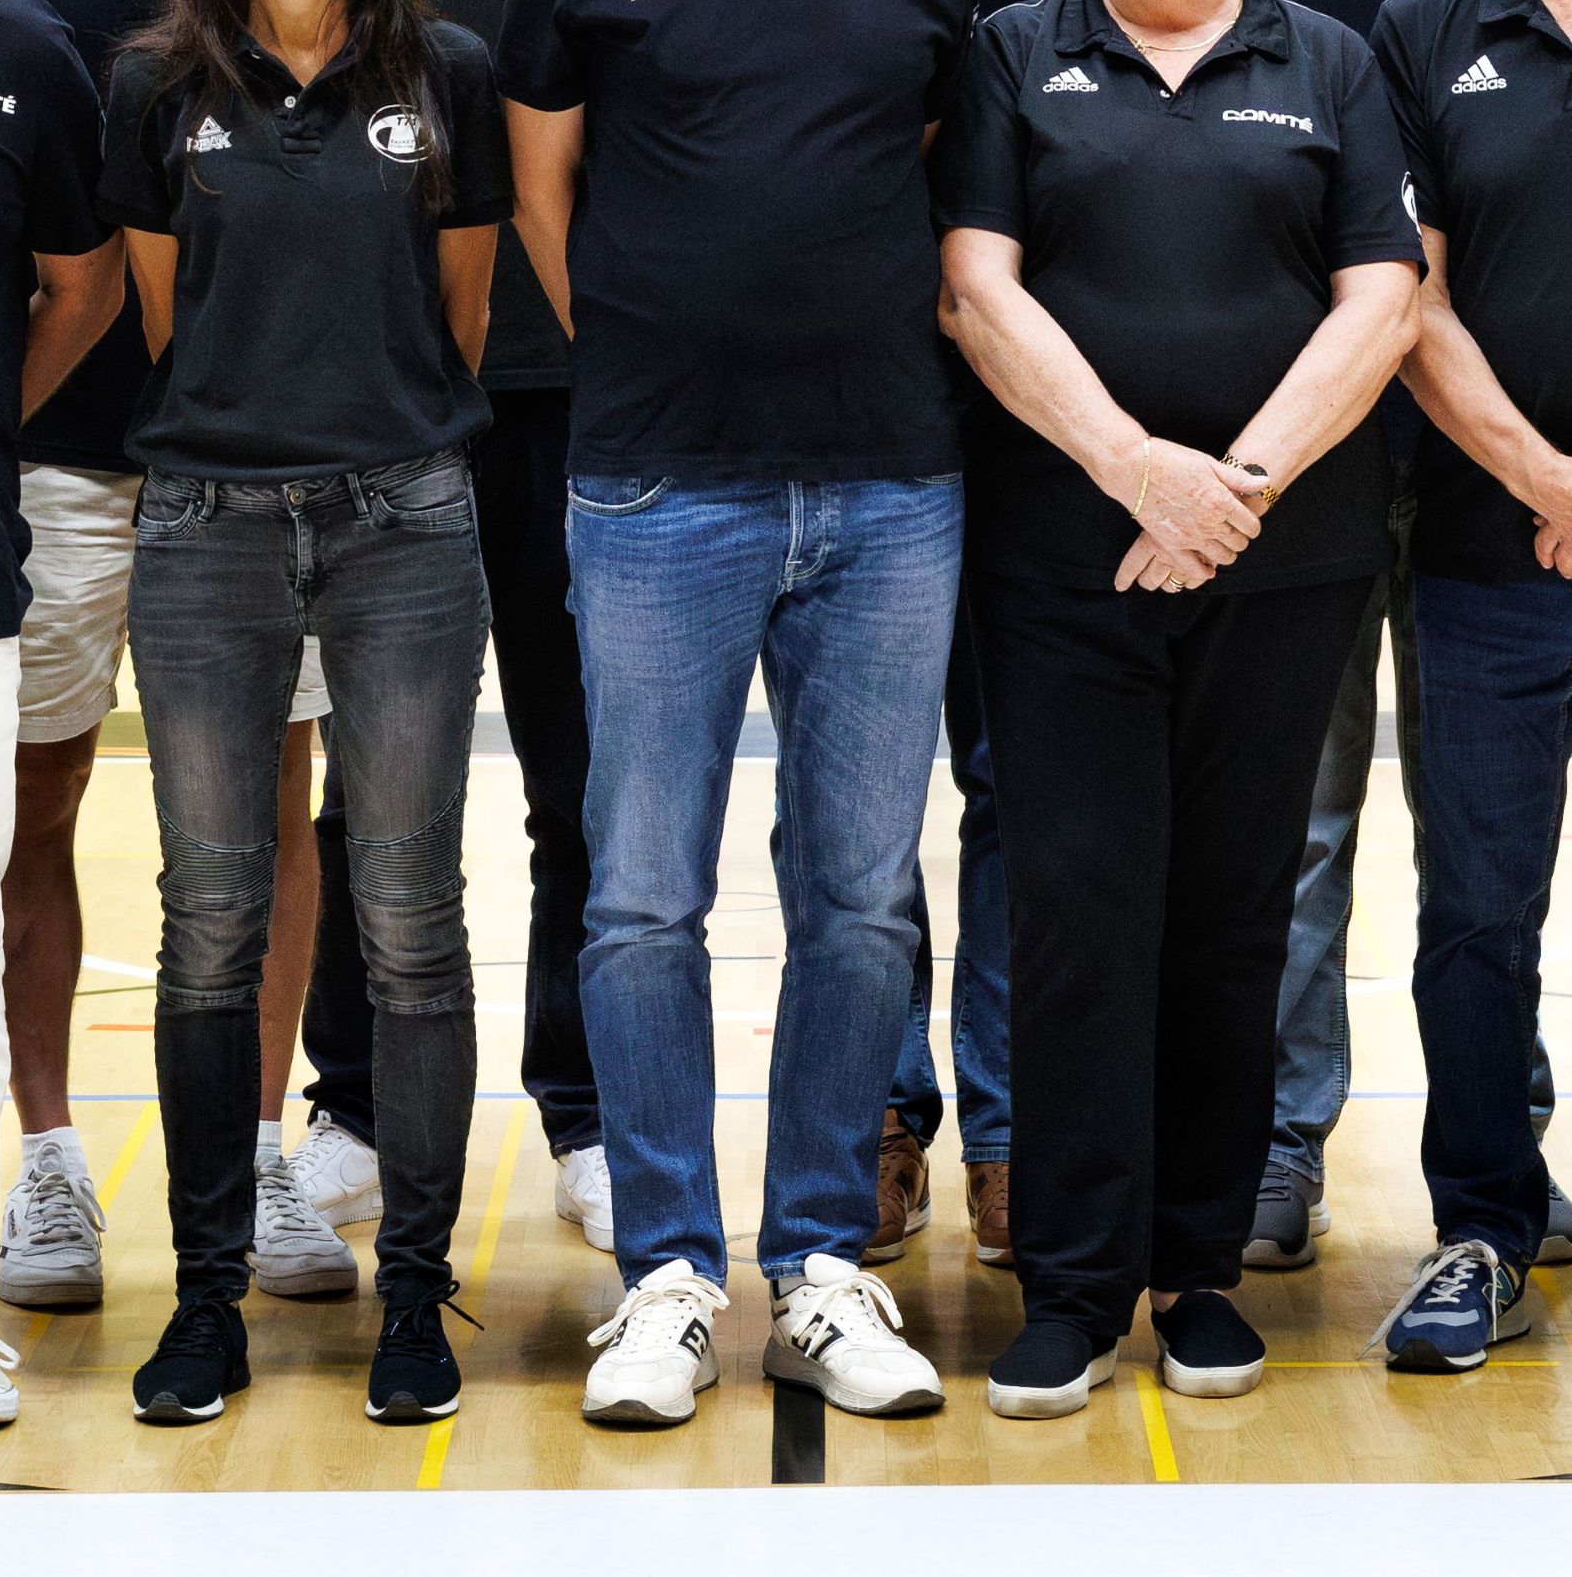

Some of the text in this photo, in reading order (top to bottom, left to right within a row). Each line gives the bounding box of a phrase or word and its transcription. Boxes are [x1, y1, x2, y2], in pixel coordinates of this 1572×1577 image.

[1451, 75, 1508, 95] adidas
[1042, 77, 1314, 134] adidas COMITÉ
